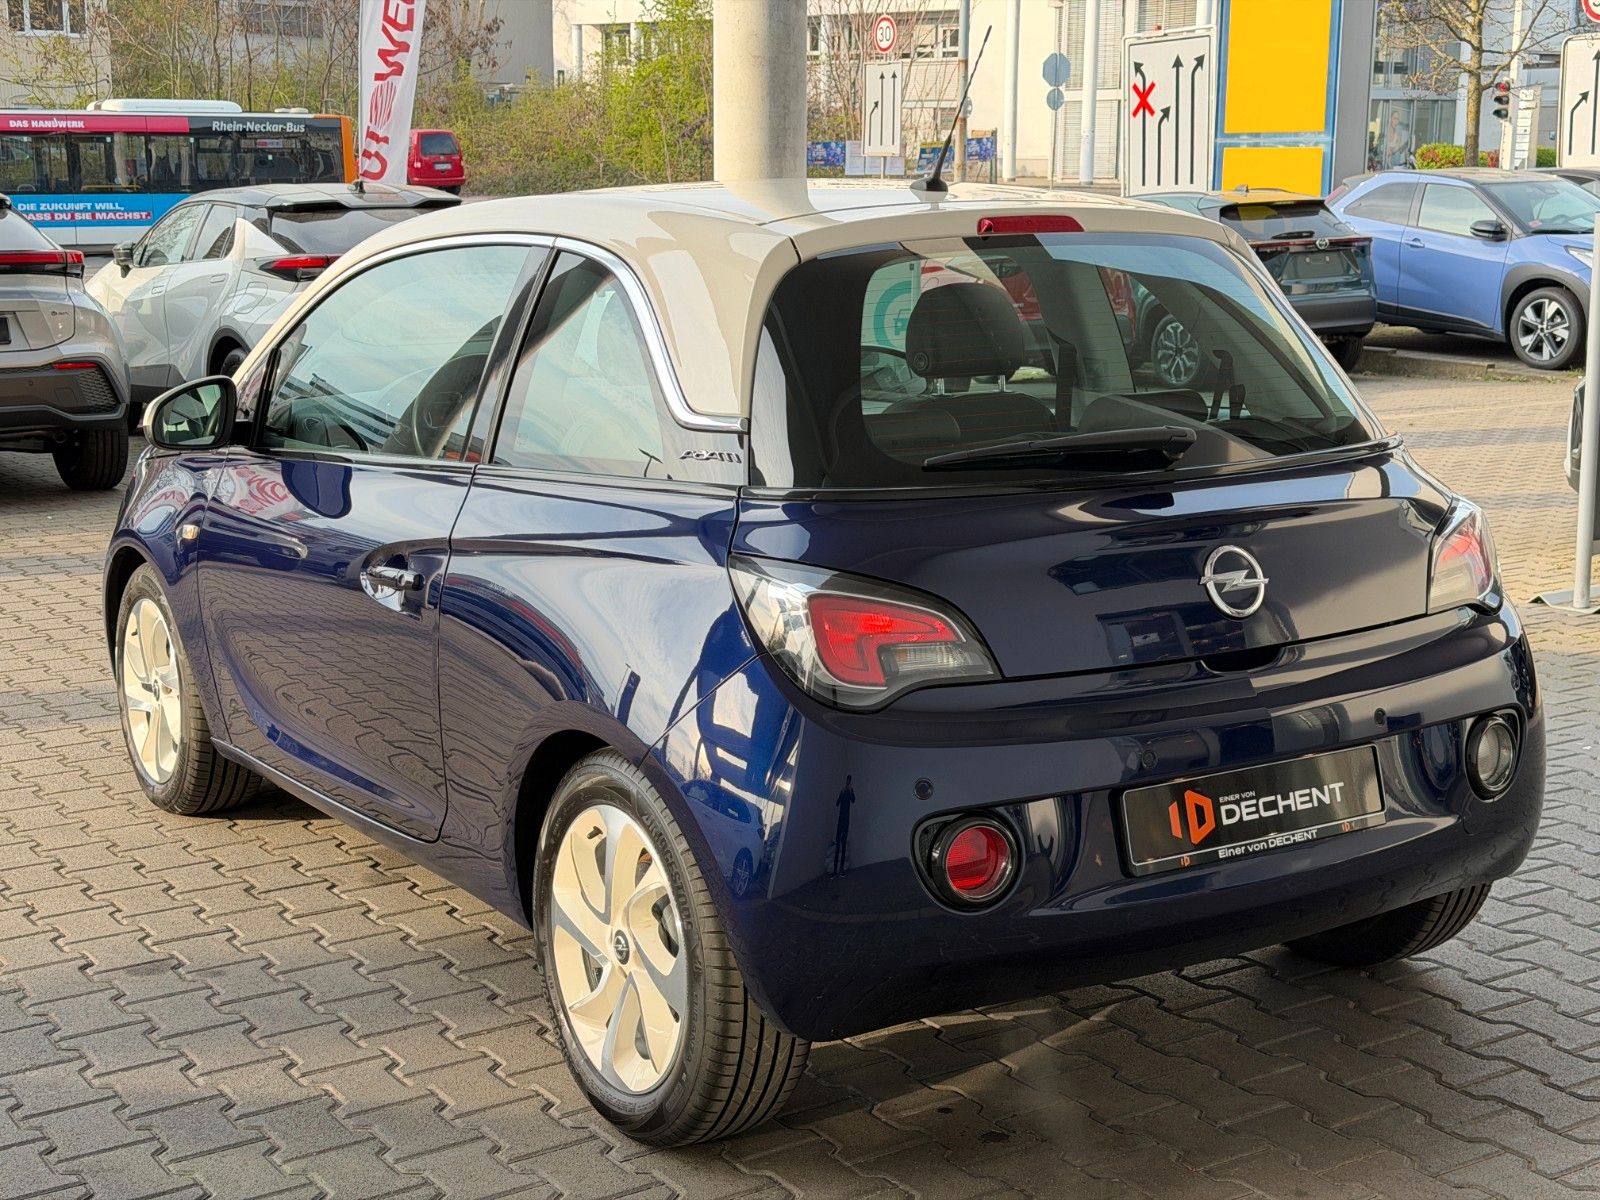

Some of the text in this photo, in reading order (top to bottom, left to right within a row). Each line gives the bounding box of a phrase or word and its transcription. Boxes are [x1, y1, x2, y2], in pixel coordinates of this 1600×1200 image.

[879, 26, 891, 42] 30
[9, 117, 85, 129] DAS HANDWERK
[212, 121, 305, 132] Rhein-Neckar-Bus
[17, 202, 125, 211] DIE ZUKUNFT WILL,
[54, 212, 72, 220] DU
[74, 212, 93, 220] SIE
[95, 211, 151, 220] MACHST.
[1219, 790, 1256, 803] EINER VON
[1220, 782, 1345, 826] DECHENT
[1218, 829, 1318, 858] Einer von DECHENT
